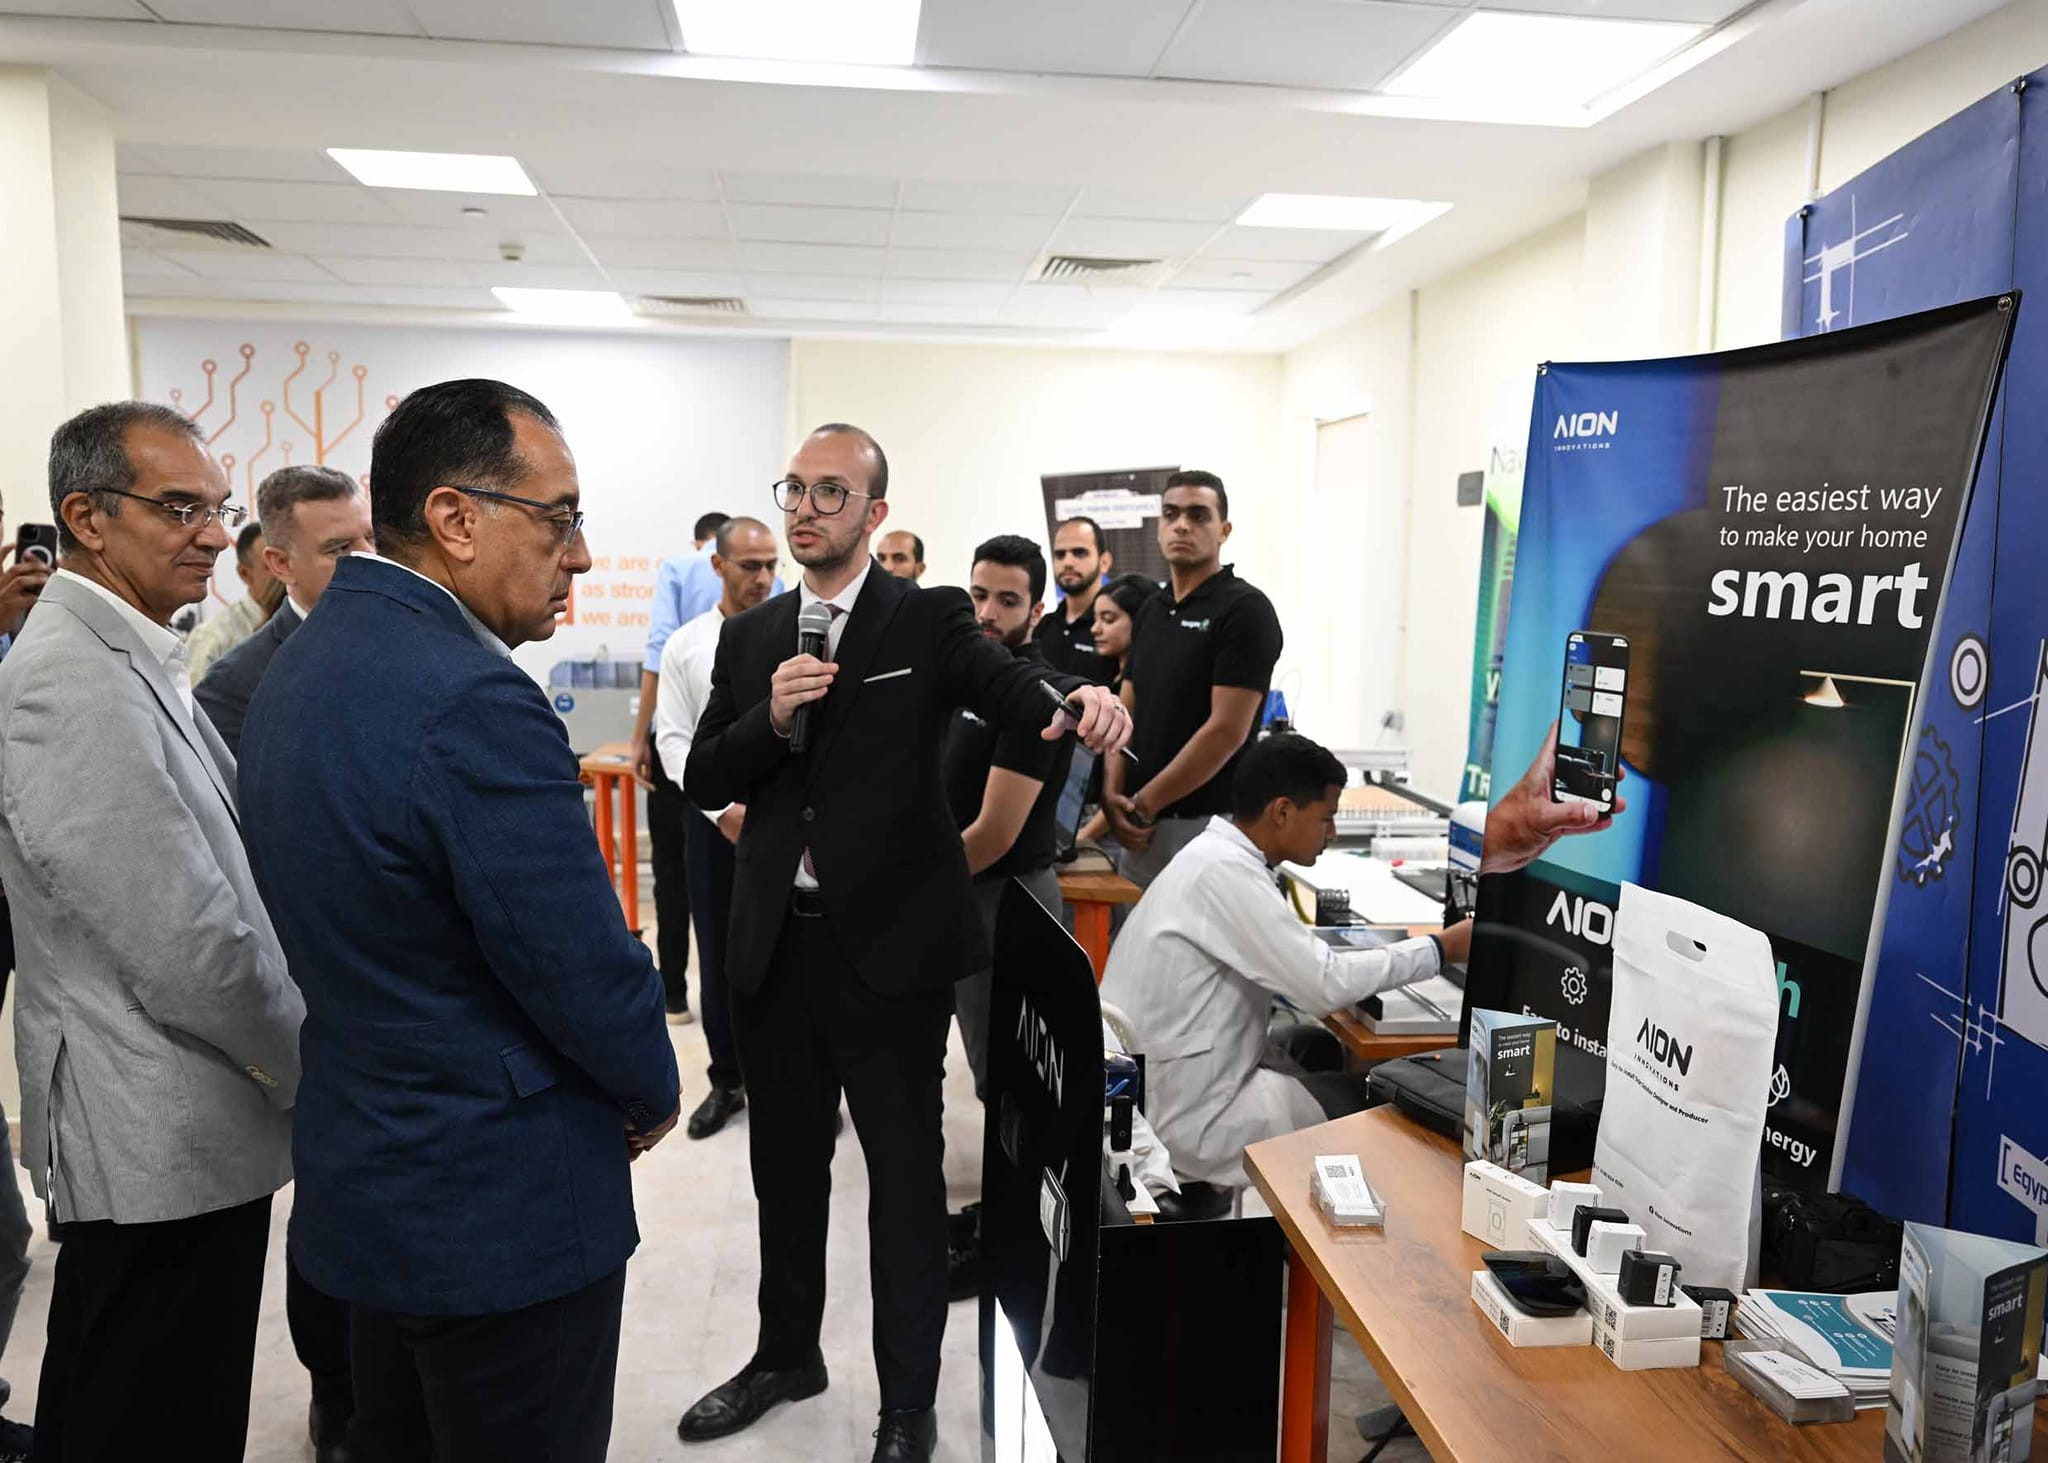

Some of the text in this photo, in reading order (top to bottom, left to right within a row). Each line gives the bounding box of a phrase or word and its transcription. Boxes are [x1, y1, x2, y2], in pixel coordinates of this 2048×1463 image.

[1553, 410, 1619, 439] AION
[1554, 442, 1611, 452] INNOVATIONS
[1722, 482, 1943, 519] The easiest way
[1719, 523, 1928, 553] to make your home
[1707, 561, 1929, 630] smart
[1556, 1021, 1570, 1041] to
[1497, 1044, 1531, 1060] smart
[1637, 1017, 1693, 1076] AION
[1633, 1053, 1679, 1091] INNOVATIONS
[1678, 1107, 1709, 1124] Producer
[1988, 1293, 2024, 1321] smart
